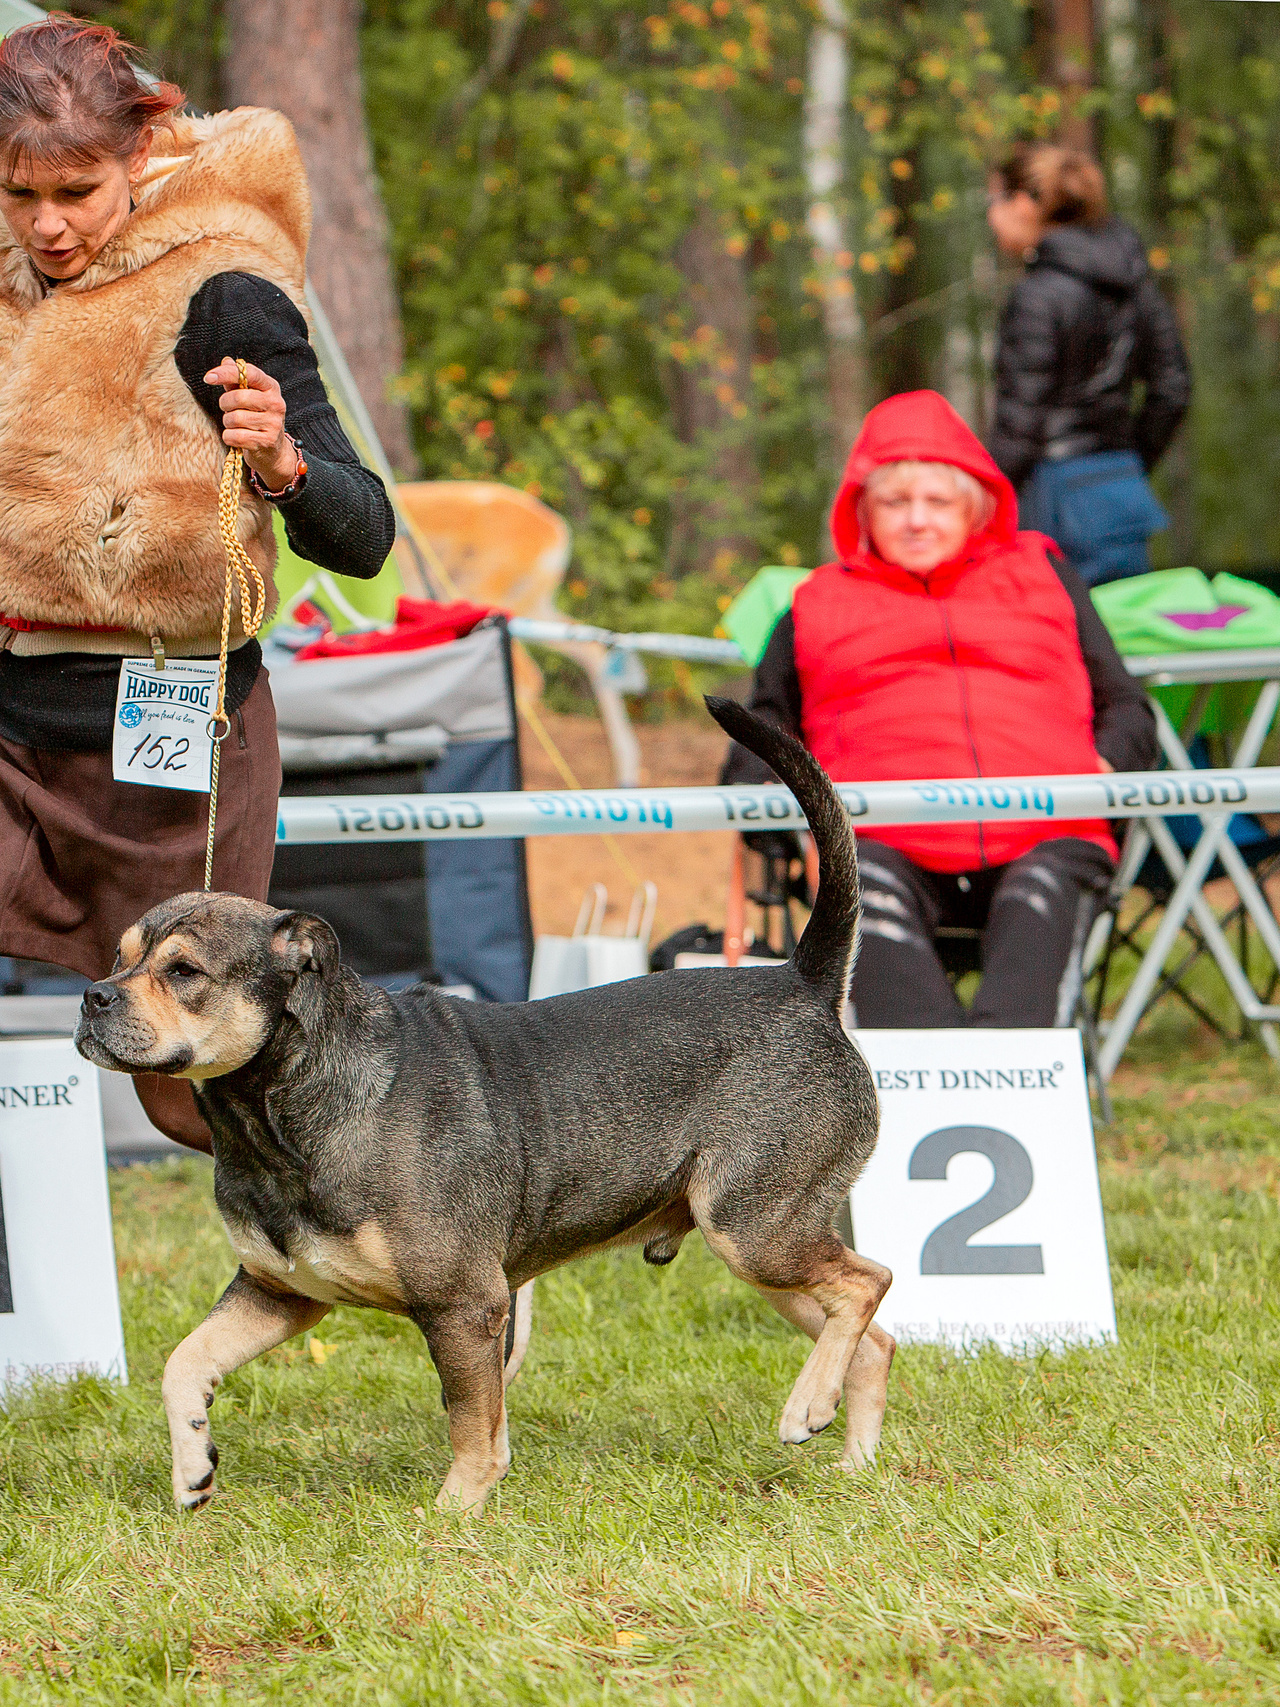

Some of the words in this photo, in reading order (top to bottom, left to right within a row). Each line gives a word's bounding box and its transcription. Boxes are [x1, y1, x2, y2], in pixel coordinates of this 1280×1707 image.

[127, 660, 149, 668] SUPREME
[125, 675, 178, 700] HAPPY
[178, 684, 212, 708] DOG
[147, 711, 160, 722] you
[127, 733, 190, 771] 152
[875, 1070, 931, 1090] EST
[907, 1124, 1046, 1275] 2
